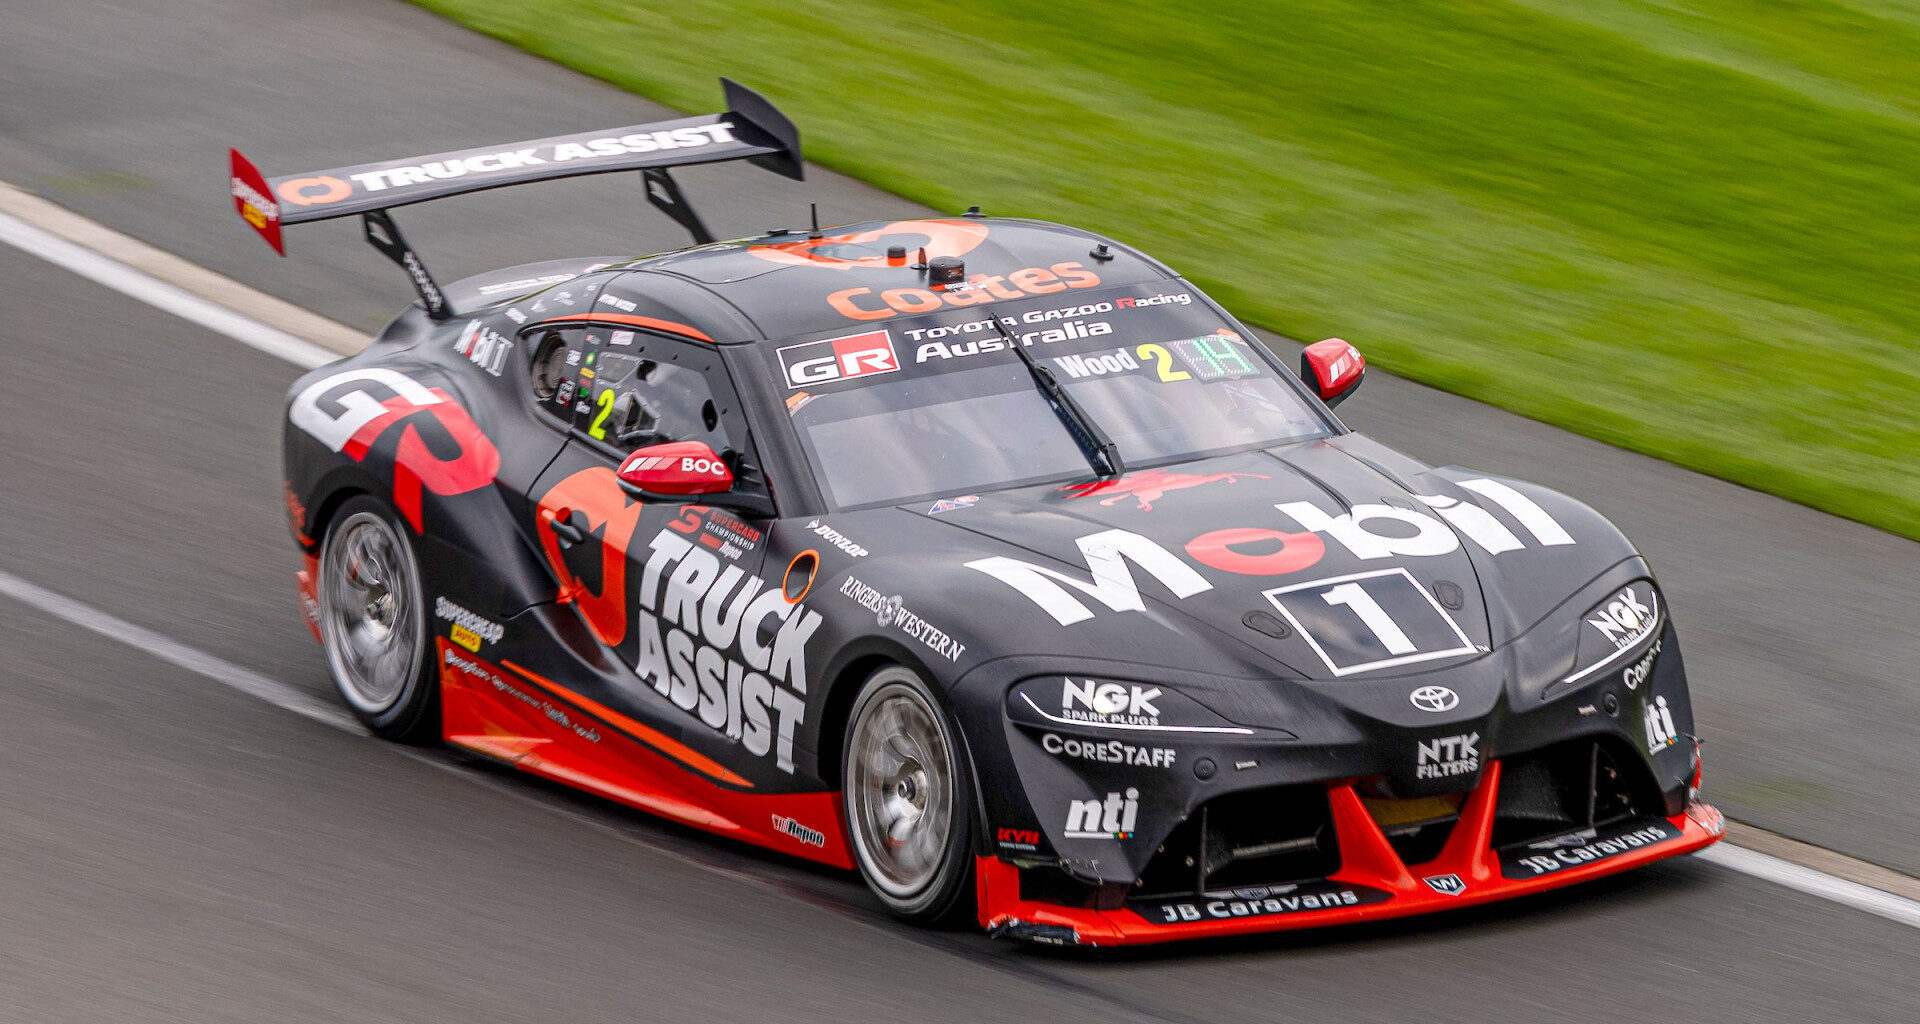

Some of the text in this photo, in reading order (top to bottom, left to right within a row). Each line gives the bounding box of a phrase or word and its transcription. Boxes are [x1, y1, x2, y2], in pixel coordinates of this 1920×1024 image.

[351, 121, 736, 192] TRUCK ASSIST
[826, 260, 1102, 321] Coates
[904, 292, 1191, 341] TOYOTA GAZOO Racing
[789, 347, 895, 384] GR
[1053, 343, 1193, 384] Wood 2
[588, 388, 616, 440] 2
[289, 367, 502, 536] GR
[681, 457, 725, 476] BOC
[705, 521, 755, 551] CHAMPIONSHIP
[814, 524, 869, 558] DUNLOP
[963, 478, 1577, 626] Mobil
[639, 528, 824, 696] TRUCK
[839, 575, 966, 663] RINGERS WESTERN
[1319, 581, 1419, 656] 1
[634, 609, 806, 775] ASSIST
[1062, 676, 1163, 718] NGK
[1062, 709, 1160, 726] SPARK PLUGS
[1416, 756, 1479, 780] FILTERS
[1417, 731, 1481, 764] NTK
[1064, 786, 1140, 833] nti
[1519, 826, 1668, 875] JB Caravans
[1161, 890, 1359, 923] JB Caravans
